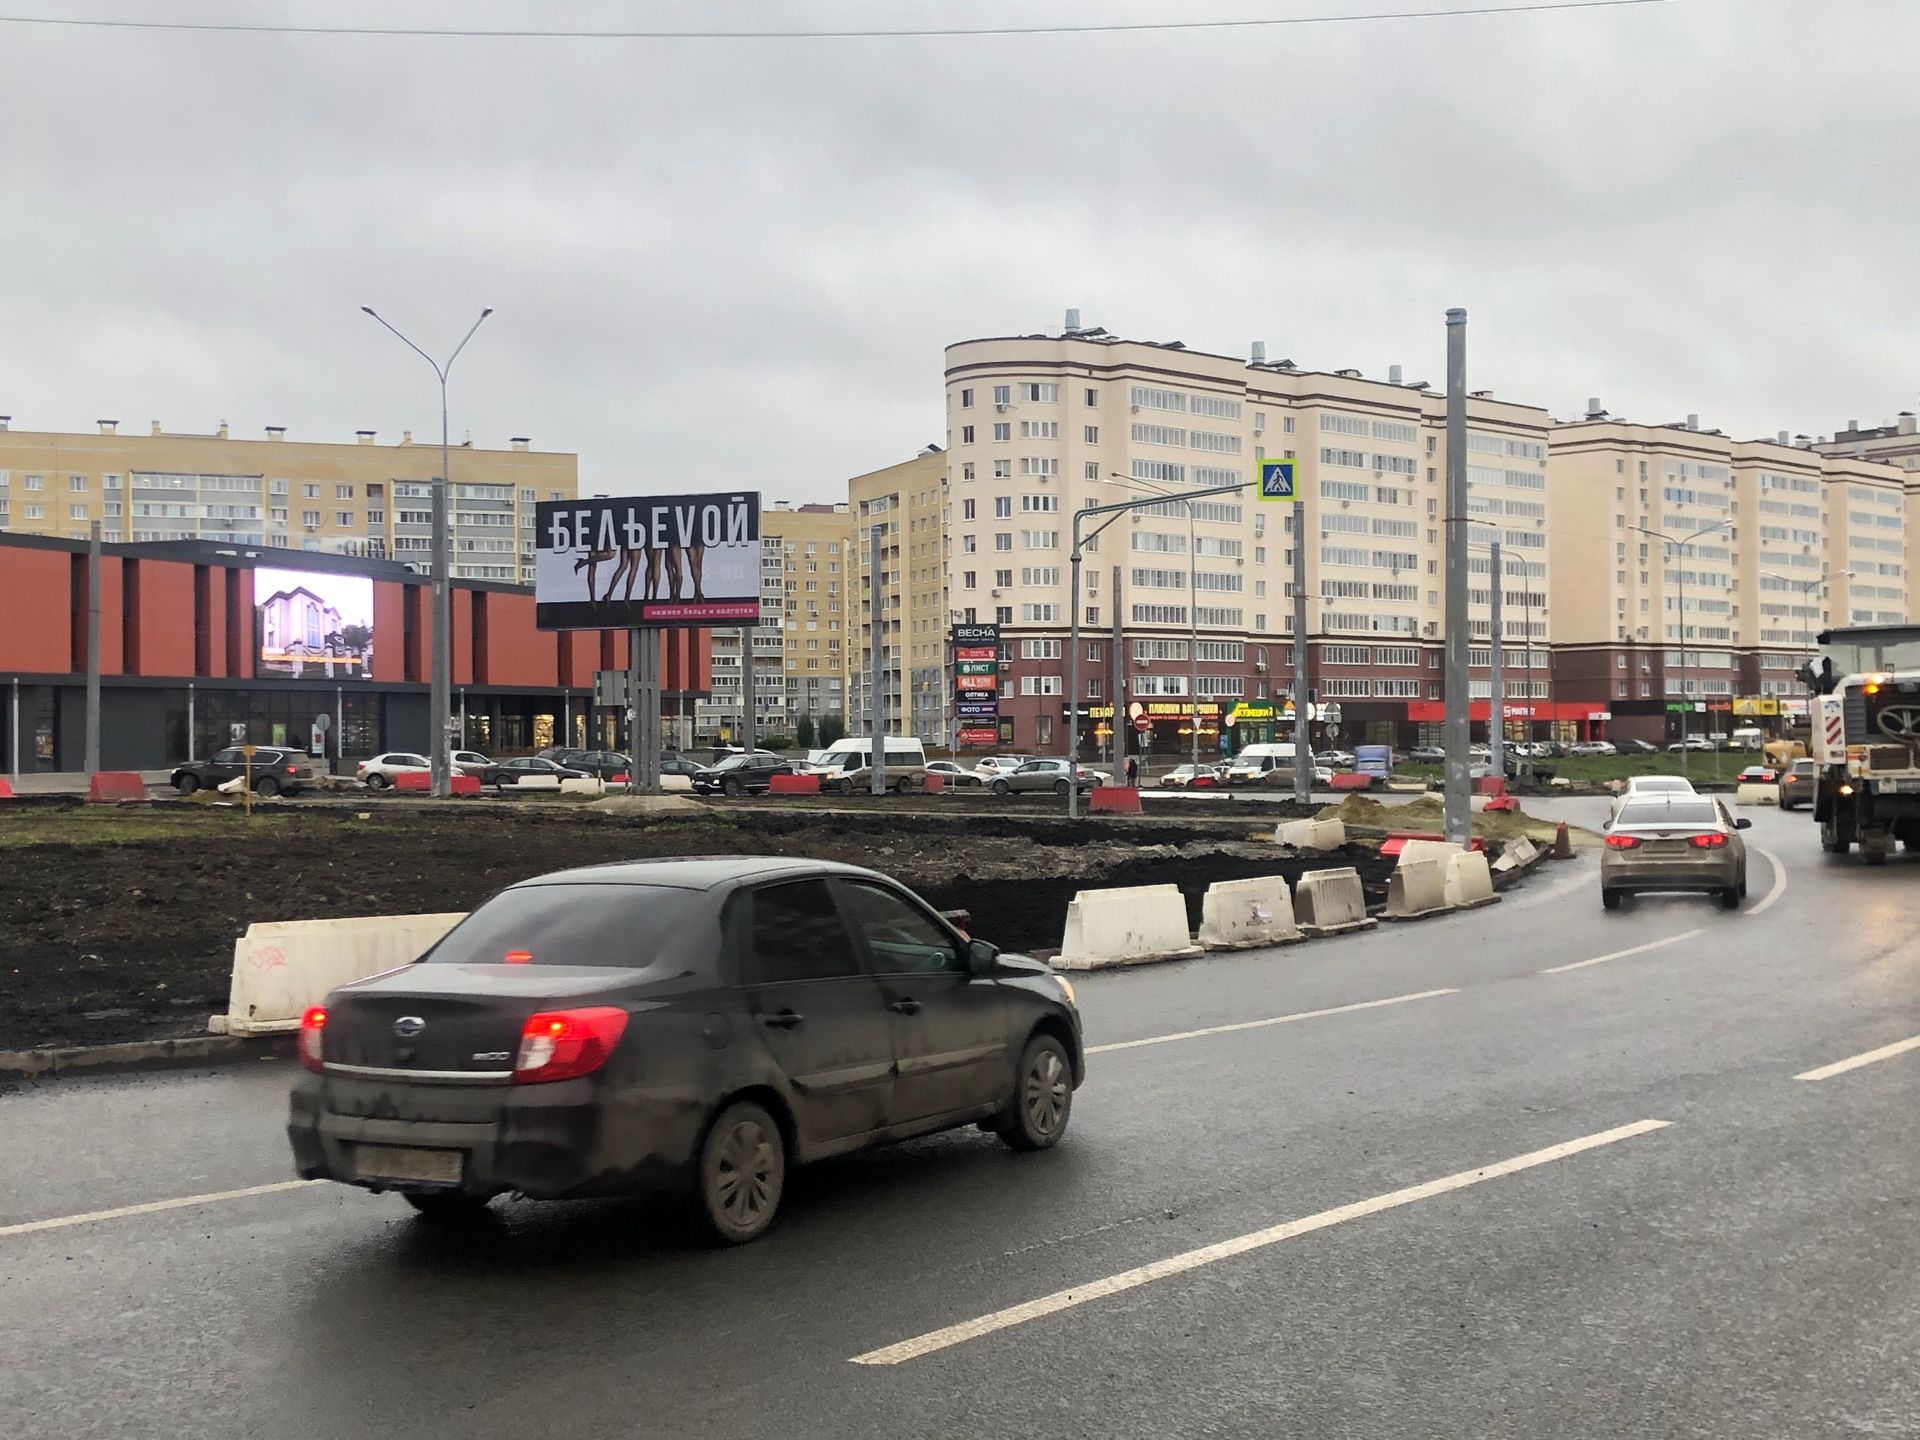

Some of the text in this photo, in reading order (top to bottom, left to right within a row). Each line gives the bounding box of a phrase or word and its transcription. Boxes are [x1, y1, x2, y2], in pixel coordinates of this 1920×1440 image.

[683, 607, 707, 615] белье
[716, 607, 754, 615] колготки
[957, 629, 995, 637] ВЕСНА
[970, 664, 990, 672] ЛИСТ
[1089, 707, 1126, 718] ПЕКАР
[1148, 703, 1181, 715] ПЛЮШКИ
